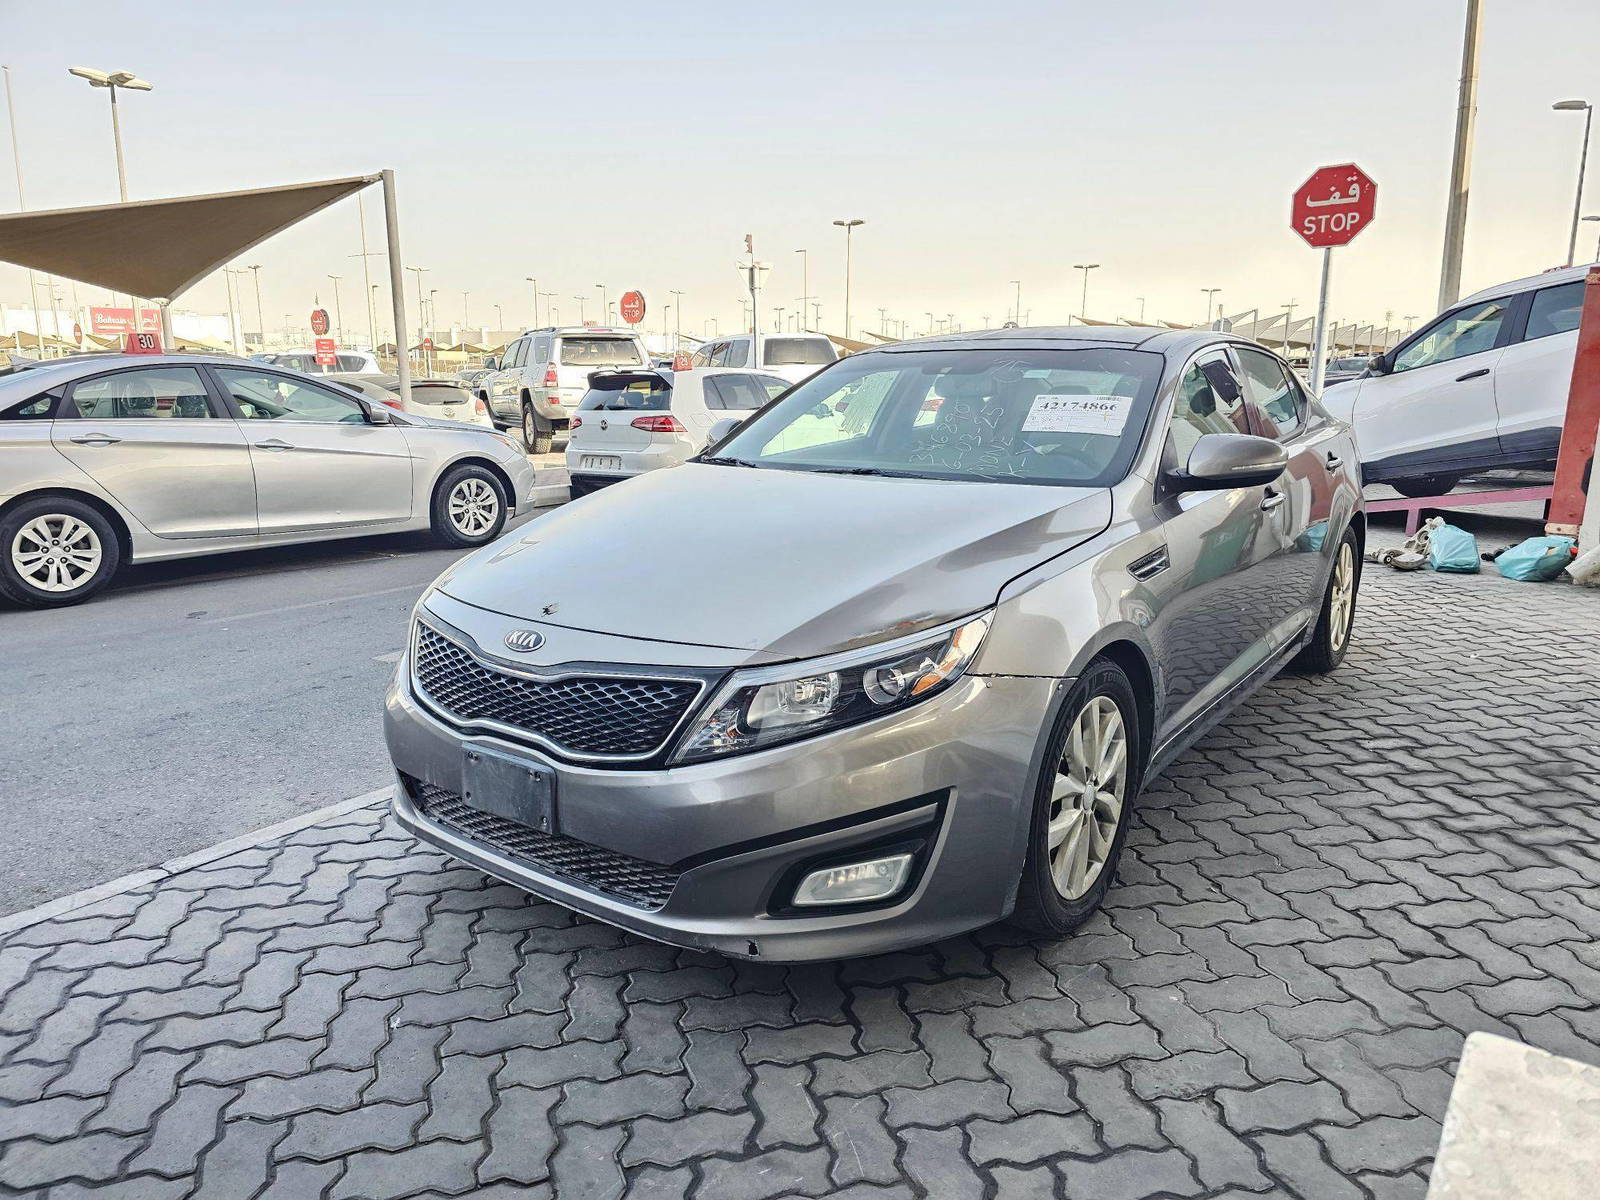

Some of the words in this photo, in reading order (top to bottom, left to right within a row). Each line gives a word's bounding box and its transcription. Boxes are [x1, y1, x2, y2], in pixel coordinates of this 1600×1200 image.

[1306, 176, 1360, 207] قف
[1303, 212, 1360, 235] STOP
[624, 310, 639, 318] STOP
[138, 334, 154, 349] 30
[508, 631, 538, 648] KIA
